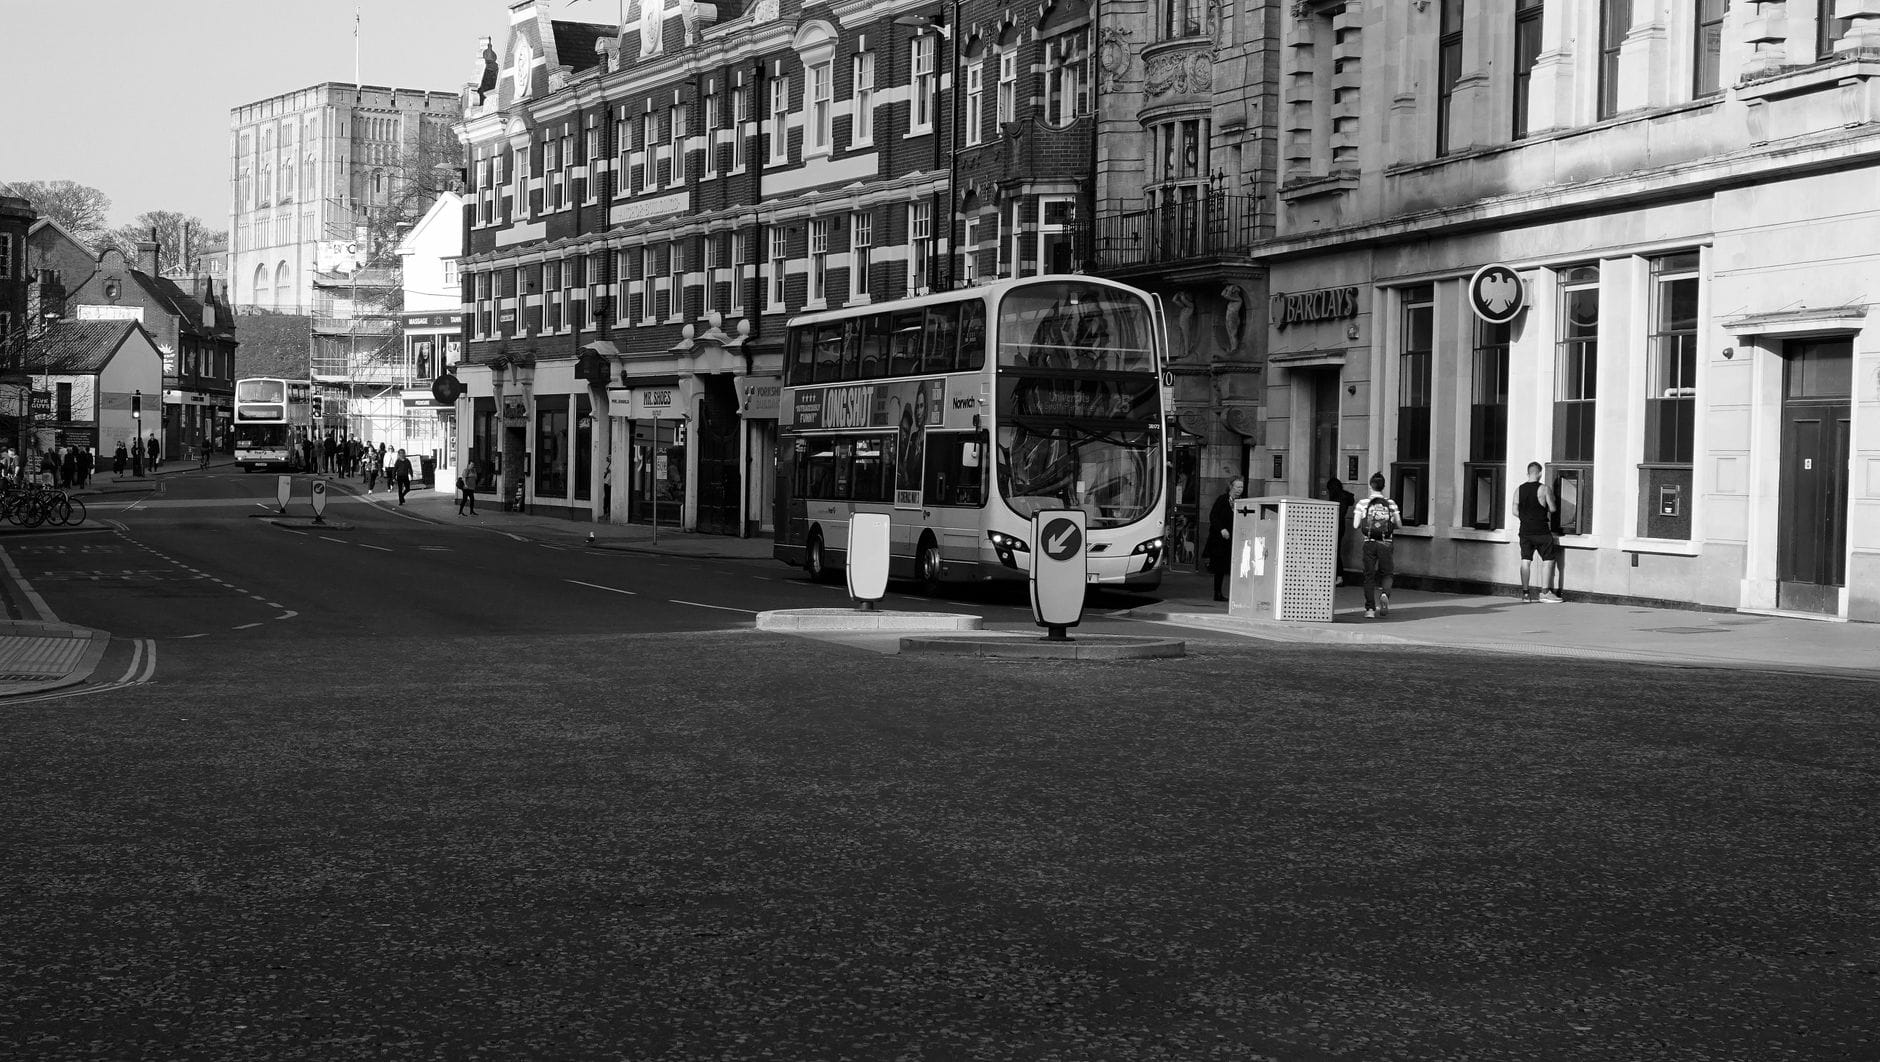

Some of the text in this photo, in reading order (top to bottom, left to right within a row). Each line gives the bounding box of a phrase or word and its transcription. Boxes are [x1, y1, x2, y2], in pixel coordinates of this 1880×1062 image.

[1287, 287, 1355, 323] BARCLAYS
[408, 317, 428, 325] MASSAGE
[653, 391, 672, 405] SHOES
[953, 396, 975, 409] Norwich
[821, 387, 847, 428] LONG
[846, 386, 874, 428] SHOT
